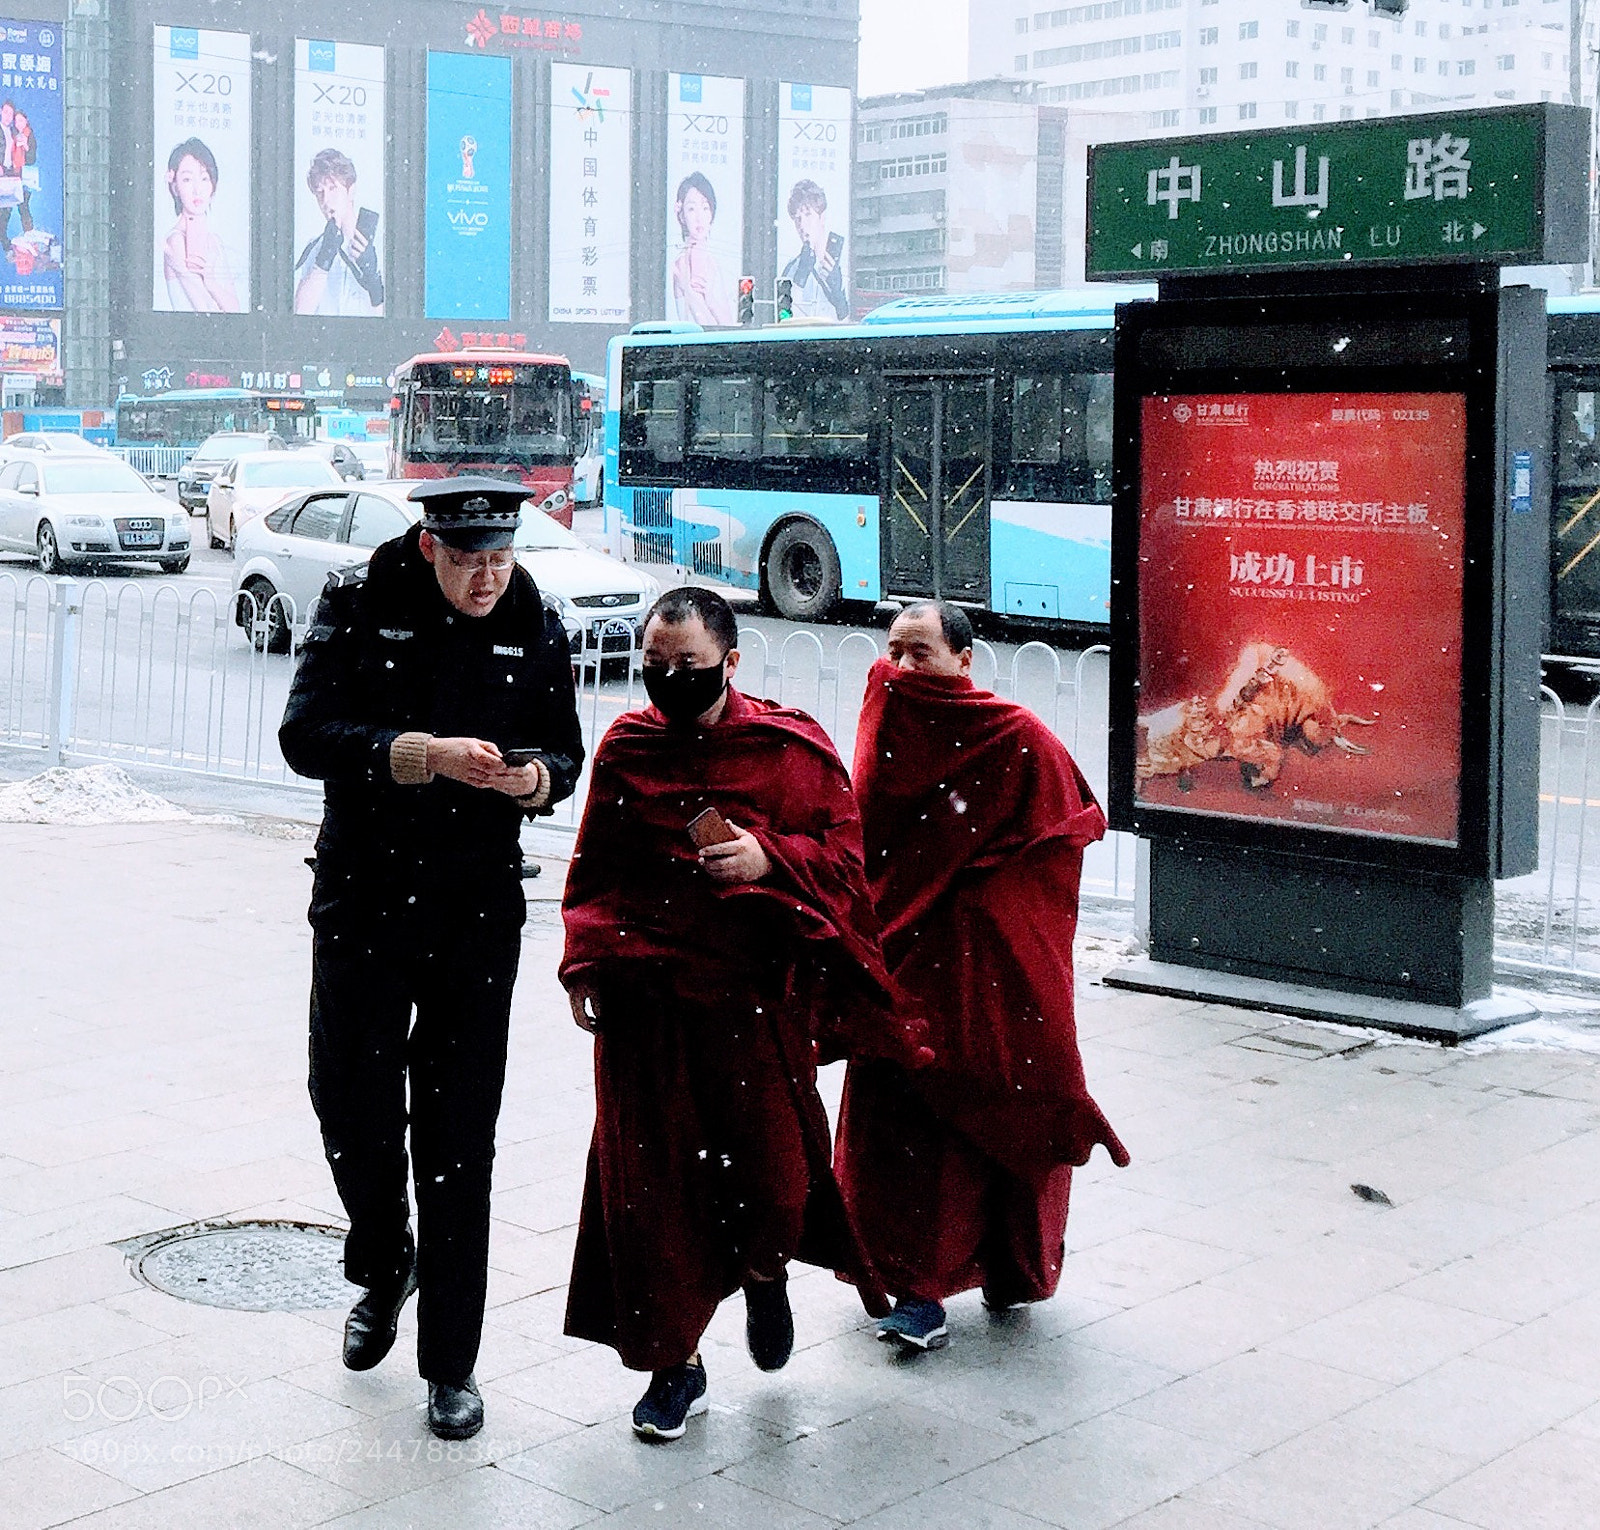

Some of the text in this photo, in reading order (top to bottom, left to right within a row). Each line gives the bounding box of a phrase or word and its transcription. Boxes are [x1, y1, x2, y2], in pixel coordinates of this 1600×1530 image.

[175, 71, 232, 96] X20
[312, 82, 367, 107] X20
[683, 113, 729, 135] X20
[793, 120, 837, 143] X20
[1147, 132, 1472, 220] 中山路
[581, 127, 598, 297] 中国体育彩票
[1204, 224, 1401, 257] ZHONGSHAN LU
[1442, 220, 1465, 243] 北
[1196, 403, 1250, 417] 甘肃银行
[1254, 459, 1339, 481] 热烈祝贺
[1173, 496, 1429, 524] 甘肃银行在香港联交所主板
[1229, 551, 1365, 589] 成功上市
